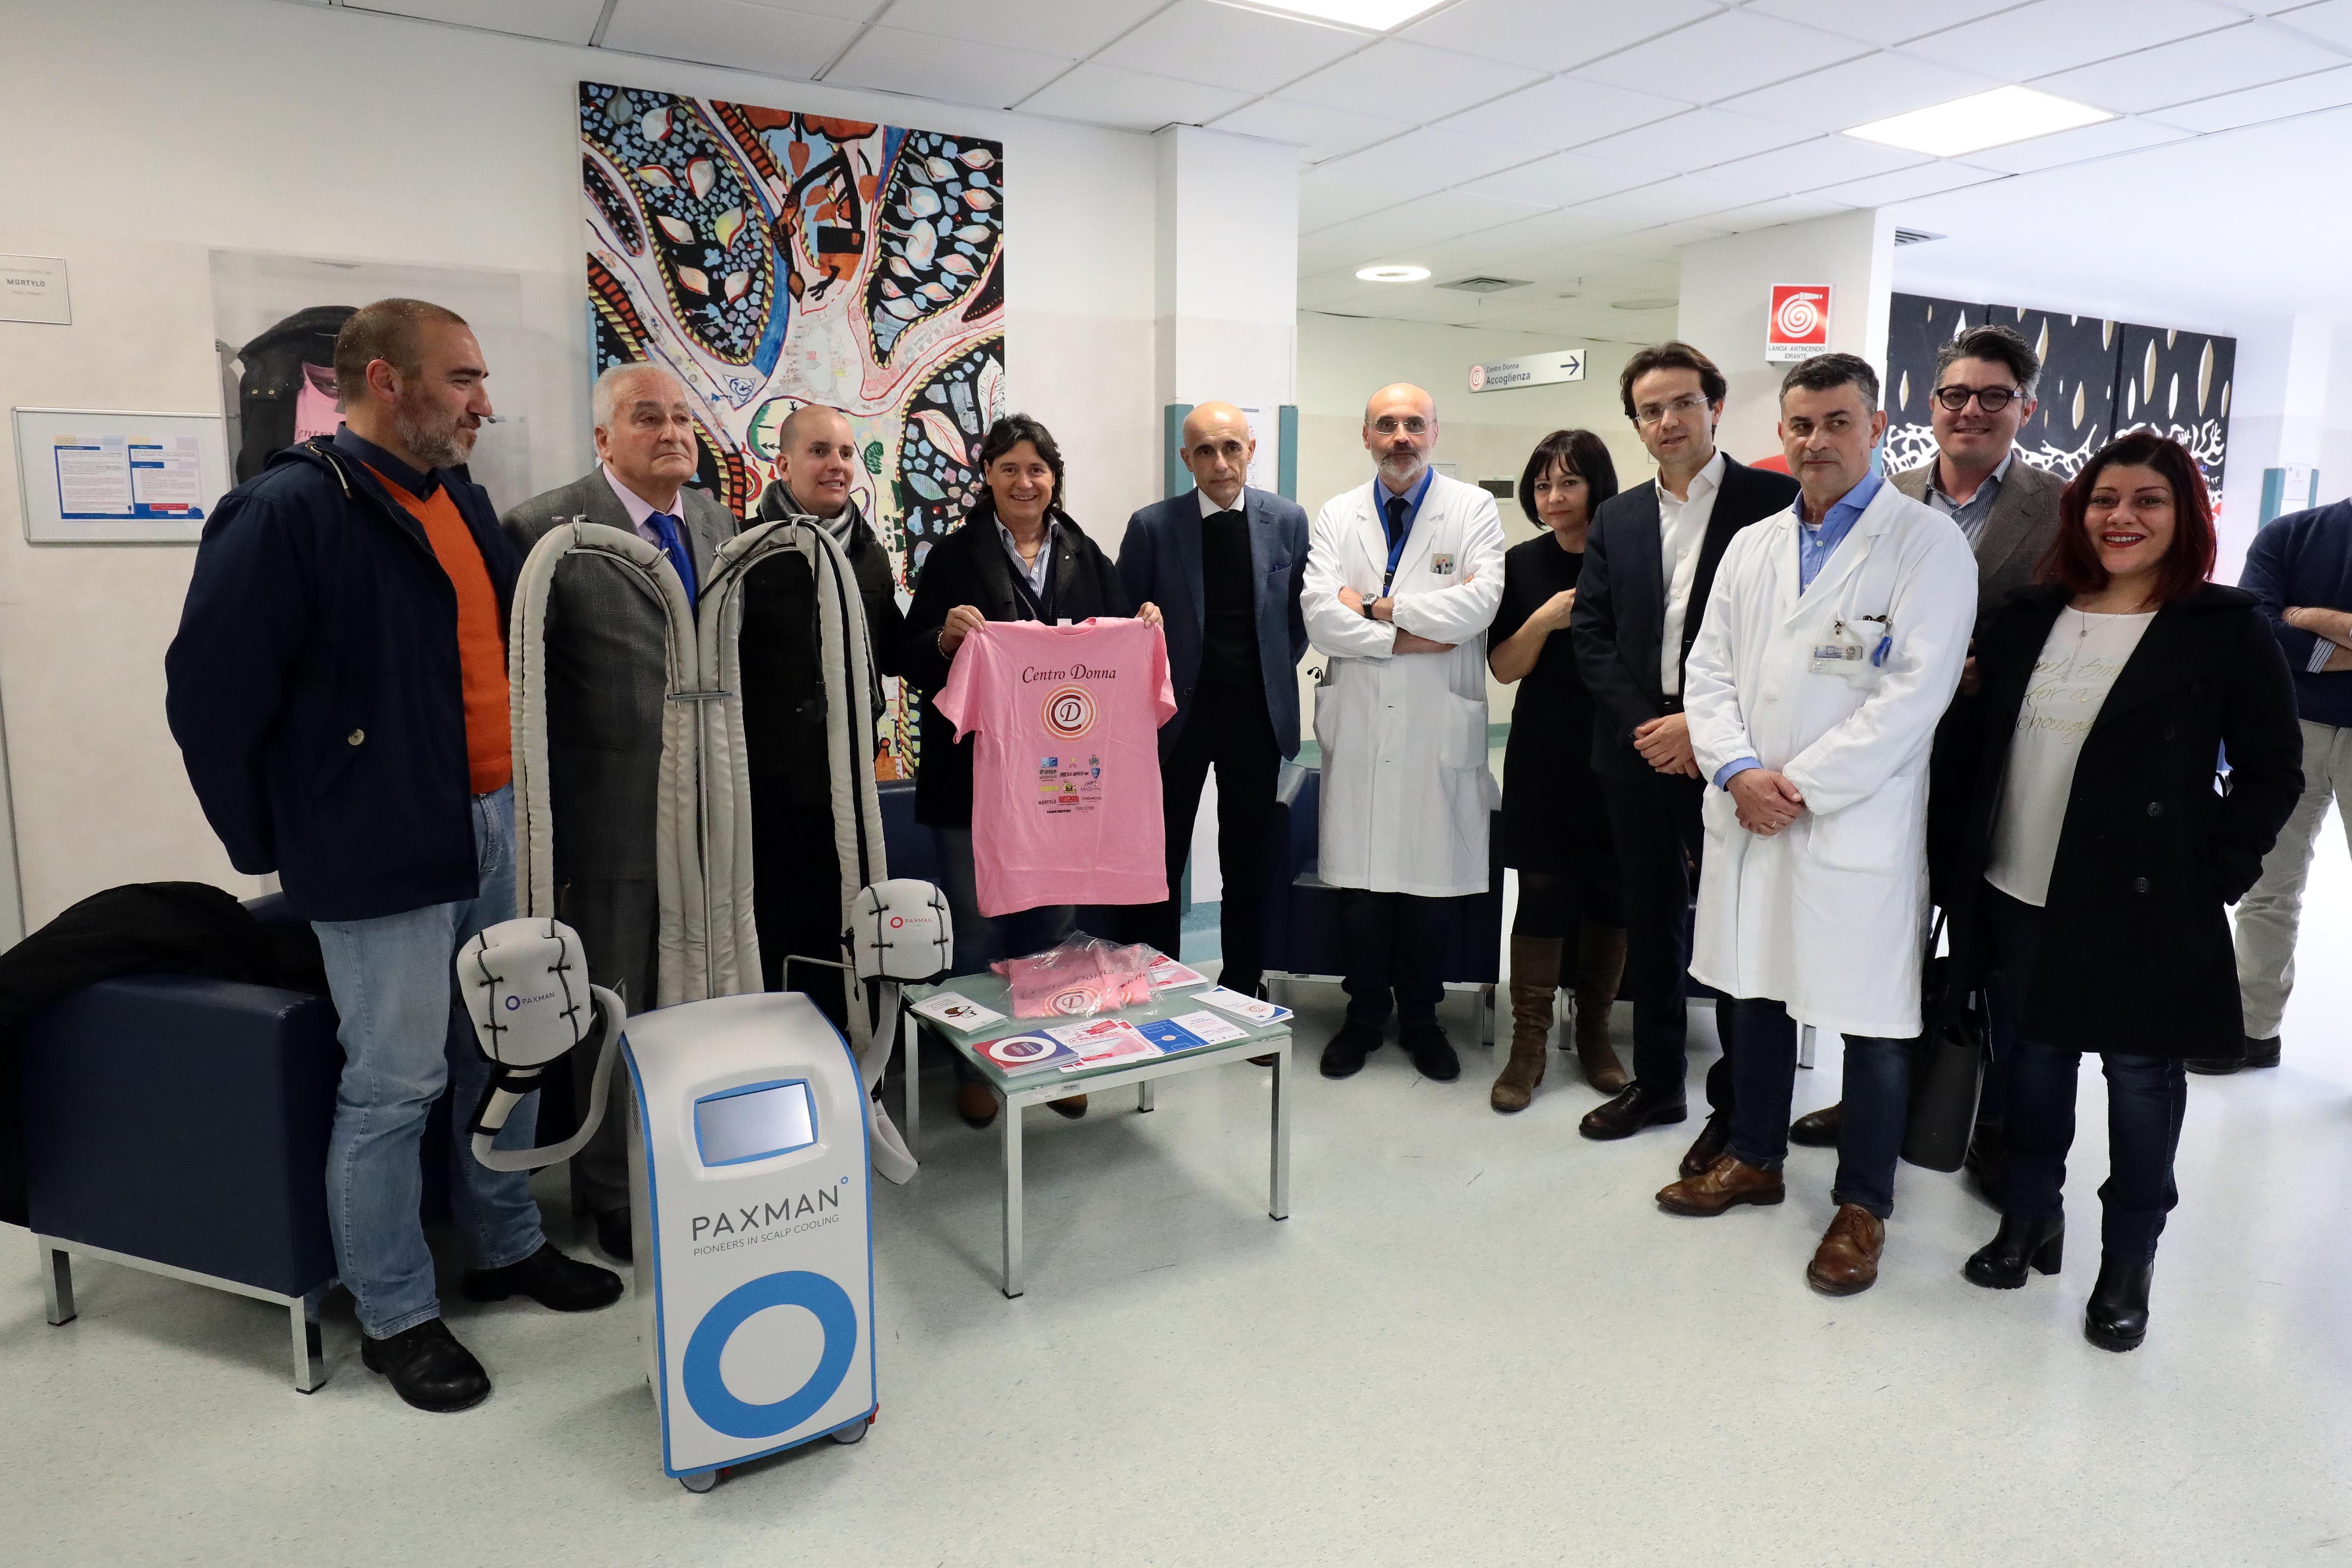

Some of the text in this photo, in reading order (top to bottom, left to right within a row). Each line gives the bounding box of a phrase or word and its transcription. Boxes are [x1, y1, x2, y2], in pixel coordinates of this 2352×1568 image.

[1486, 373, 1531, 385] Accoglienza
[1022, 664, 1116, 683] Centro Donna
[522, 992, 555, 1005] PAXMAN
[692, 1185, 838, 1241] PAXMAN
[693, 1214, 839, 1257] PIONEERS IN SCALP COOLING
